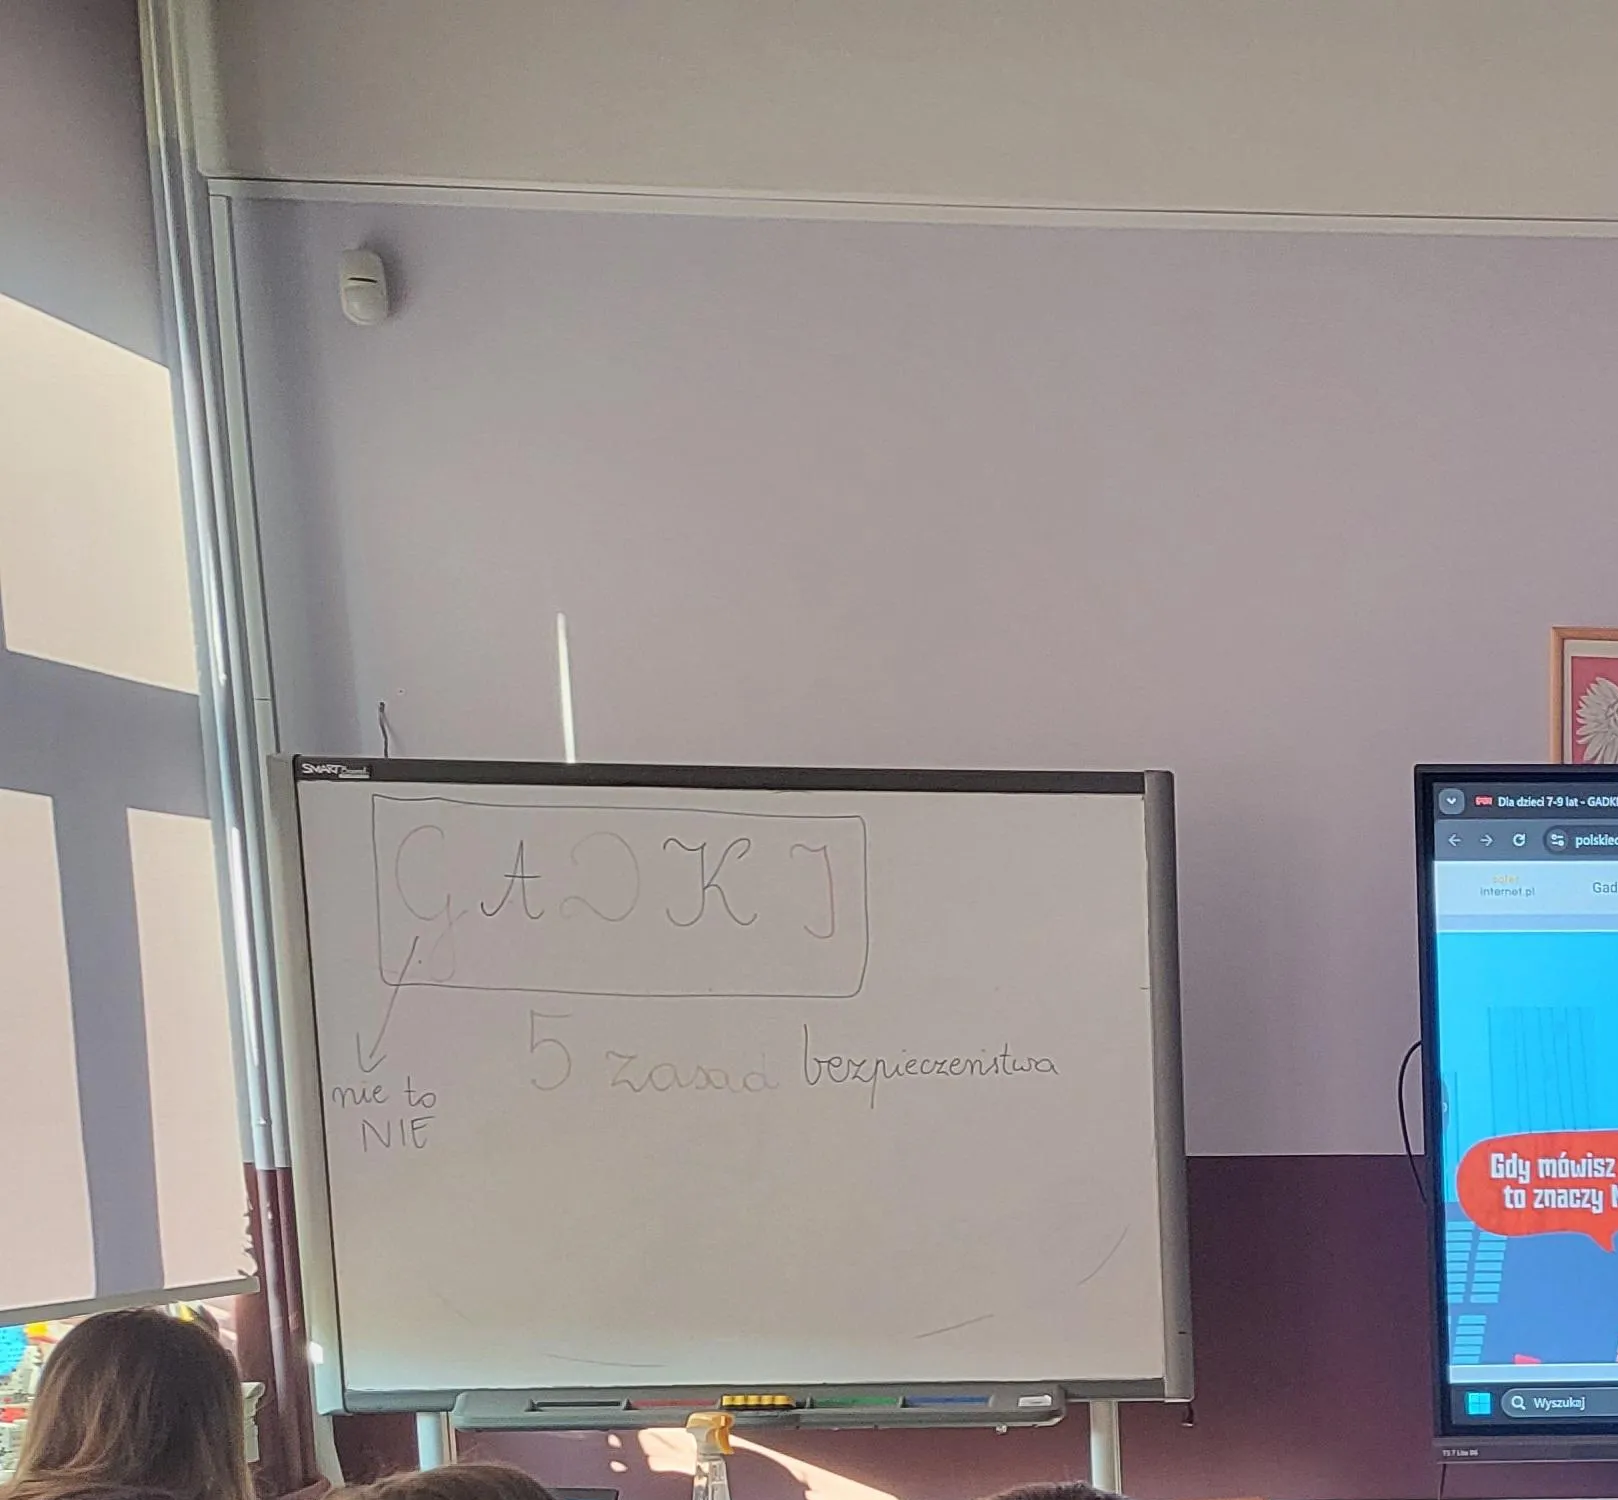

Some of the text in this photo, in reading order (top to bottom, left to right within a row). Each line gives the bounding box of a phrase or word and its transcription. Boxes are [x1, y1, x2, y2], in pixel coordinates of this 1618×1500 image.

[1498, 796, 1515, 807] Dla
[1517, 796, 1544, 807] dzieci
[1547, 796, 1564, 807] 7-9
[1565, 796, 1579, 807] lat
[529, 1009, 573, 1091] 5
[332, 1076, 437, 1109] nie to
[362, 1116, 436, 1152] NIE
[1490, 1152, 1531, 1184] Gdy
[1537, 1152, 1616, 1178] mówisz
[1503, 1185, 1527, 1209] to
[1533, 1188, 1604, 1214] znaczy
[1533, 1396, 1586, 1412] Wyszukaj
